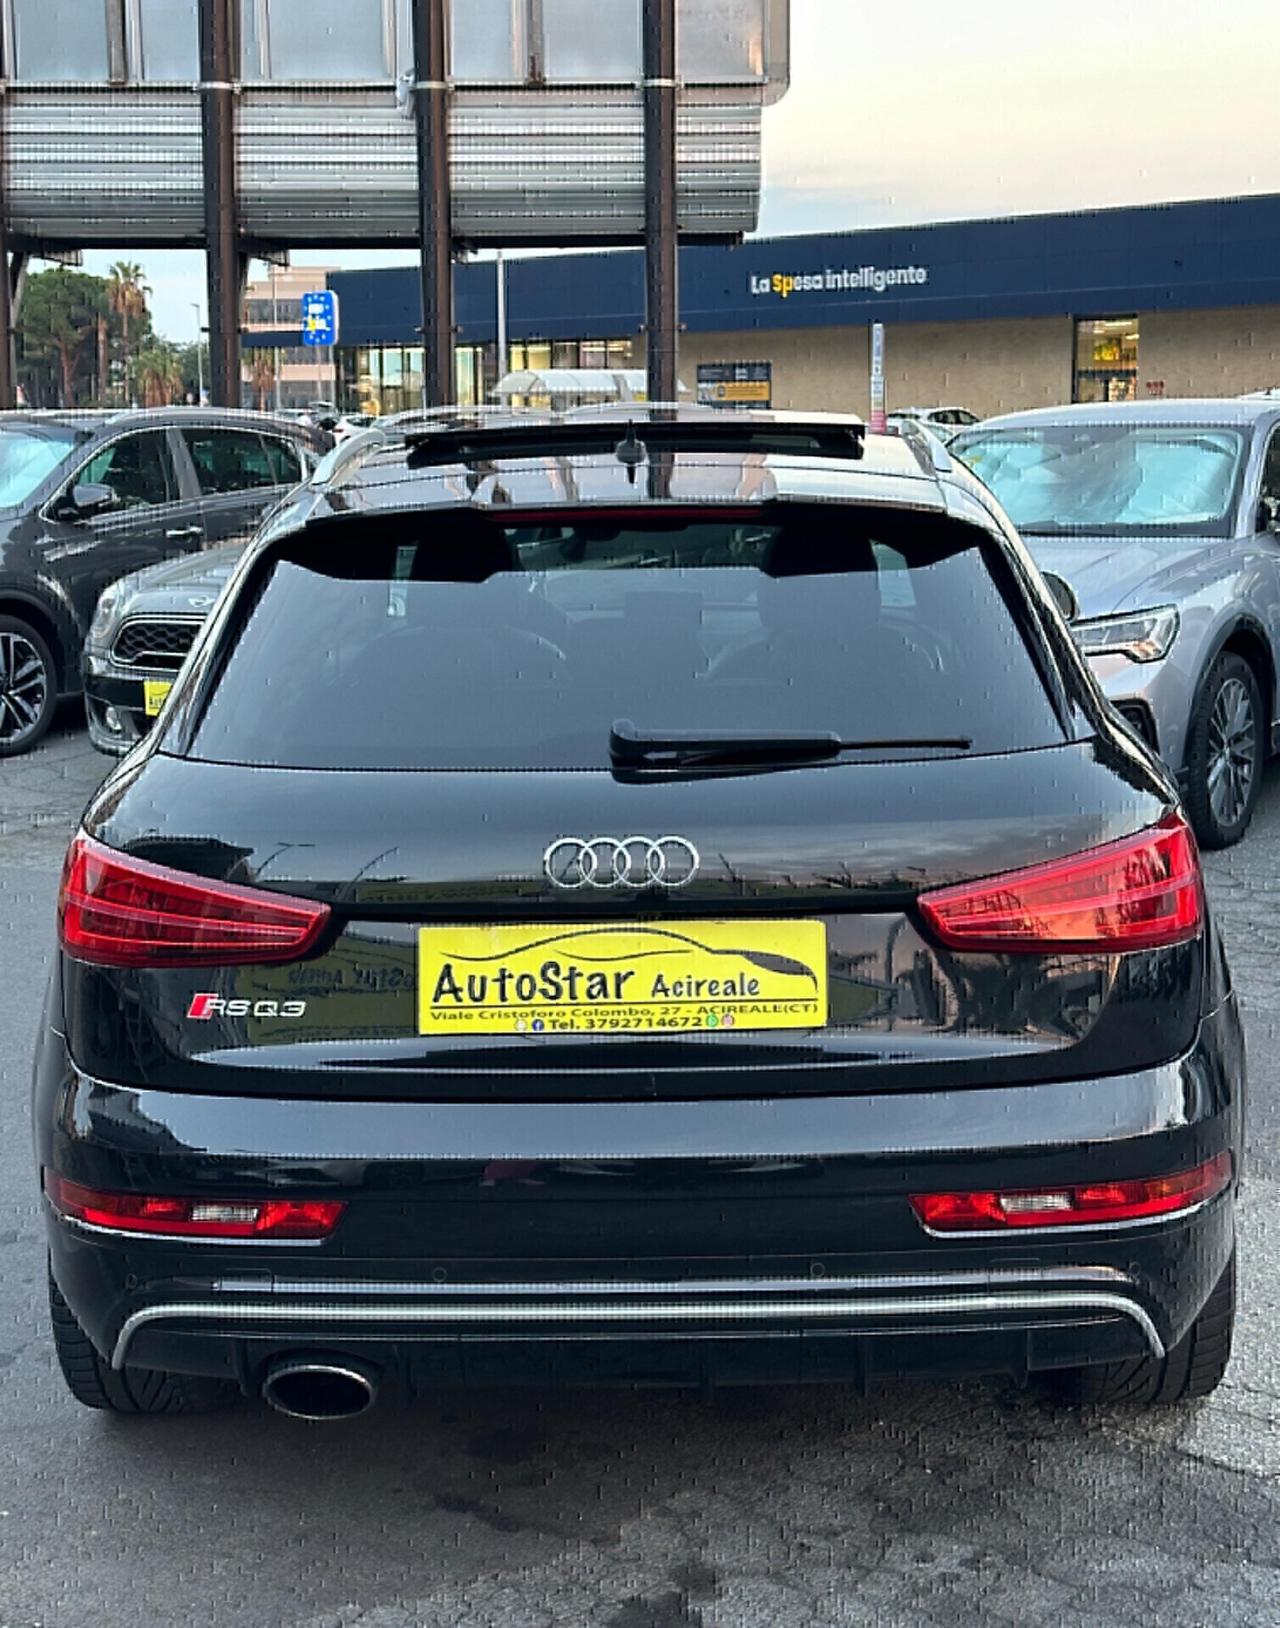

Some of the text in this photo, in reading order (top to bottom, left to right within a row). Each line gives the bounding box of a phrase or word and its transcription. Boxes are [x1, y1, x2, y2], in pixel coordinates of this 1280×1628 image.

[751, 266, 927, 298] La Spesa intelligente
[433, 960, 636, 1003] AutoStar
[651, 972, 760, 998] Acireale
[431, 1011, 474, 1020] Viale
[479, 1009, 567, 1020] Cristoforo
[571, 1006, 655, 1018] Colombo,
[658, 1006, 681, 1016] 27
[697, 1003, 818, 1015] ACIREALE(CT)
[548, 1016, 702, 1030] Tel. 3792714672
